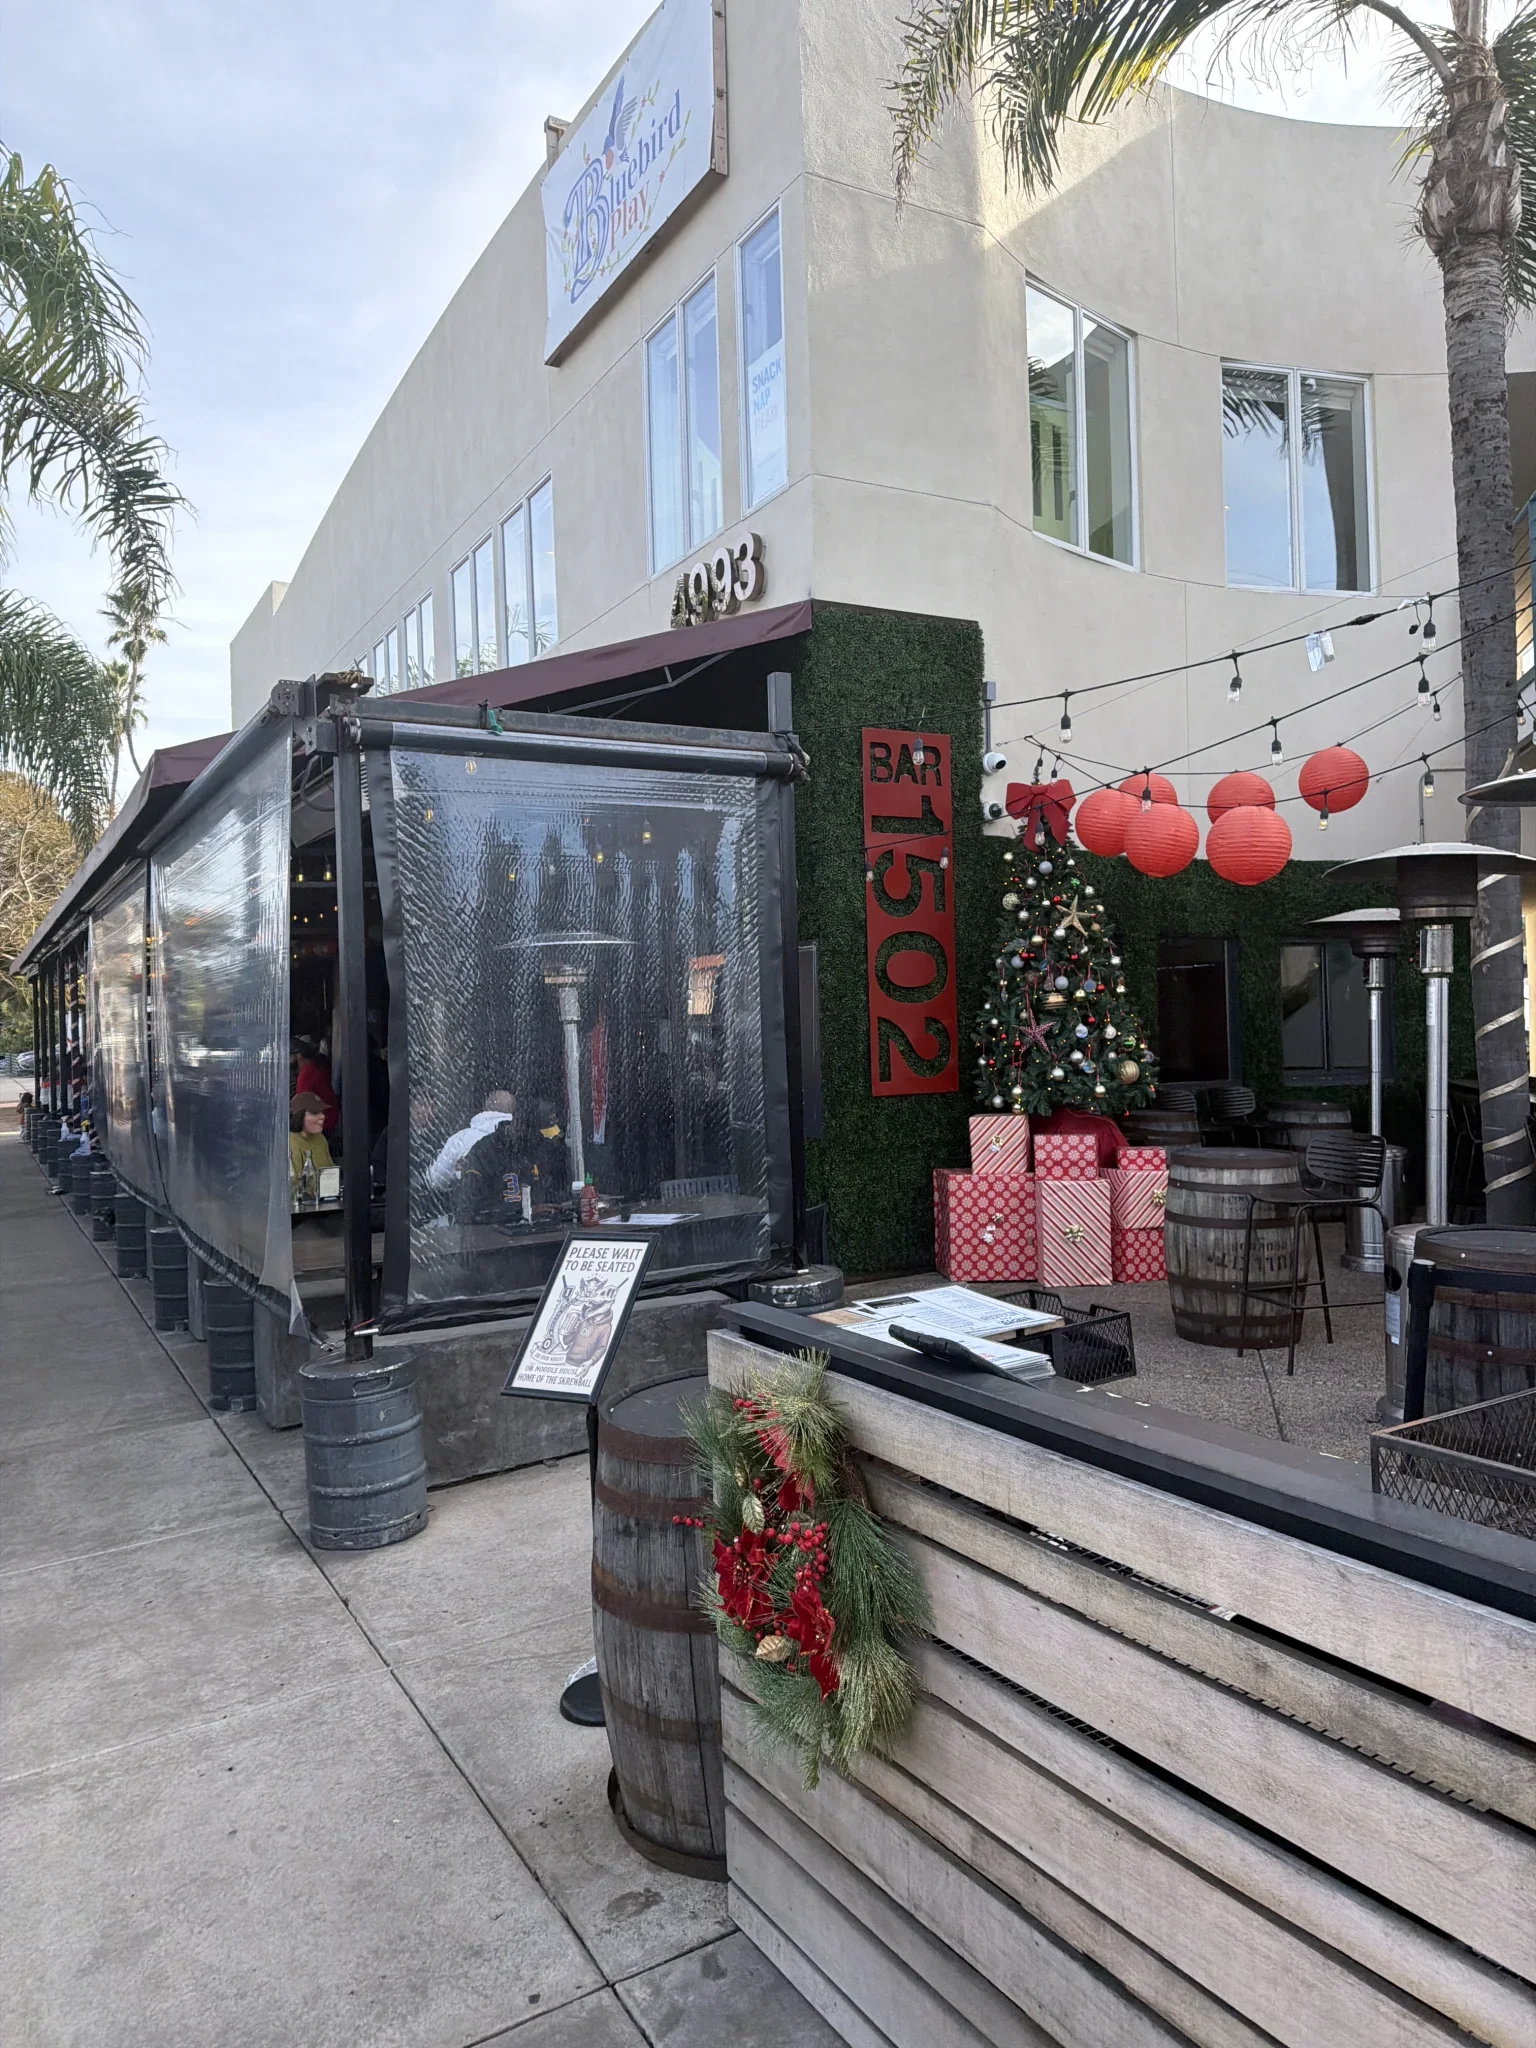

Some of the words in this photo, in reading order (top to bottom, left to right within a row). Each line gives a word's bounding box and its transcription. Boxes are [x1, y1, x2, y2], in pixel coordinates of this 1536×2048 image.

[564, 88, 682, 305] Bluebird
[751, 355, 783, 394] SNACK
[752, 387, 771, 415] NAP
[670, 531, 764, 629] 4993
[869, 741, 943, 788] BAR
[871, 794, 952, 1083] 1502
[564, 1259, 577, 1271] TO
[579, 1260, 595, 1272] BE
[595, 1261, 636, 1273] SEATED
[568, 1246, 610, 1260] PLEASE
[611, 1248, 643, 1261] WAIT
[517, 1373, 535, 1382] HOME
[535, 1374, 546, 1384] OF
[545, 1375, 558, 1384] THE
[557, 1376, 592, 1388] SKREWBALL
[524, 1364, 534, 1372] OB
[534, 1365, 559, 1374] NOODLE
